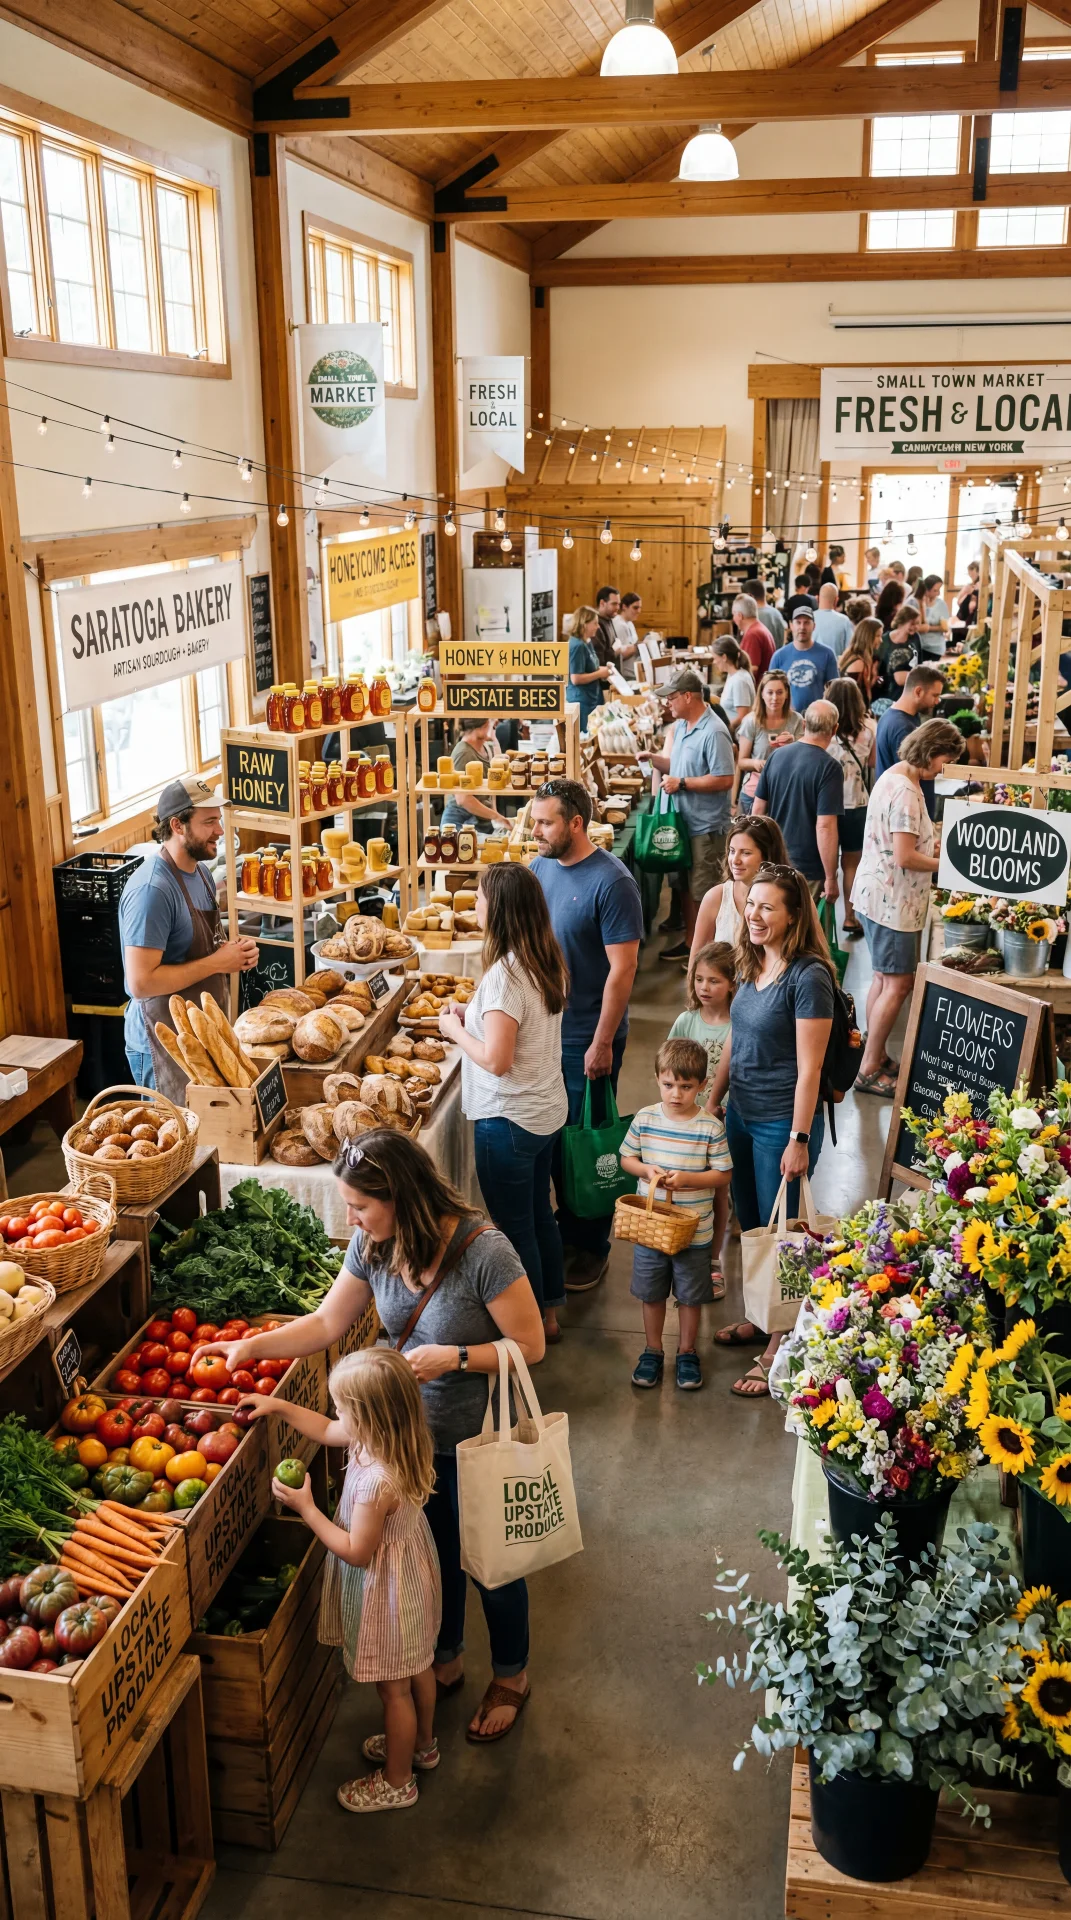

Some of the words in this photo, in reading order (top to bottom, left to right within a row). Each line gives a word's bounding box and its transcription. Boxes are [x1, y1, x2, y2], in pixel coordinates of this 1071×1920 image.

[310, 386, 376, 403] MARKET
[469, 384, 516, 400] FRESH
[877, 374, 926, 388] SMALL
[932, 374, 976, 388] TOWN
[983, 373, 1045, 388] MARKET
[469, 411, 517, 427] LOCAL
[835, 394, 943, 434] FRESH
[951, 401, 968, 424] &
[975, 393, 1071, 433] LOCA
[964, 443, 986, 452] NEW
[988, 442, 1014, 452] YORK
[329, 547, 386, 584] HONEYCOMB
[389, 541, 416, 572] ACRES
[70, 597, 169, 660] SARATOGA
[172, 582, 232, 634] BAKERY
[113, 658, 141, 679] ARTISAN
[142, 645, 181, 670] SOURDOUGH
[445, 649, 494, 666] HONEY
[511, 649, 561, 667] HONEY
[449, 688, 514, 707] UPSTATE
[519, 688, 557, 708] BEES
[239, 750, 275, 777] RAW
[231, 777, 285, 806] HONEY
[956, 820, 1060, 858] WOODLAND
[969, 853, 1041, 886] BLOOMS
[934, 996, 1015, 1049] FLOWERS
[938, 1029, 997, 1071] FLOOMS
[212, 1458, 247, 1519] LOCAL
[503, 1469, 557, 1504] LOCAL
[204, 1466, 257, 1562] UPSTATE
[504, 1489, 562, 1523] UPSTATE
[505, 1506, 565, 1541] PRODUCE
[208, 1496, 258, 1588] PRODUCE
[112, 1590, 157, 1666] LOCAL
[101, 1594, 172, 1718] UPSTATE
[105, 1627, 173, 1747] PRODUCE
